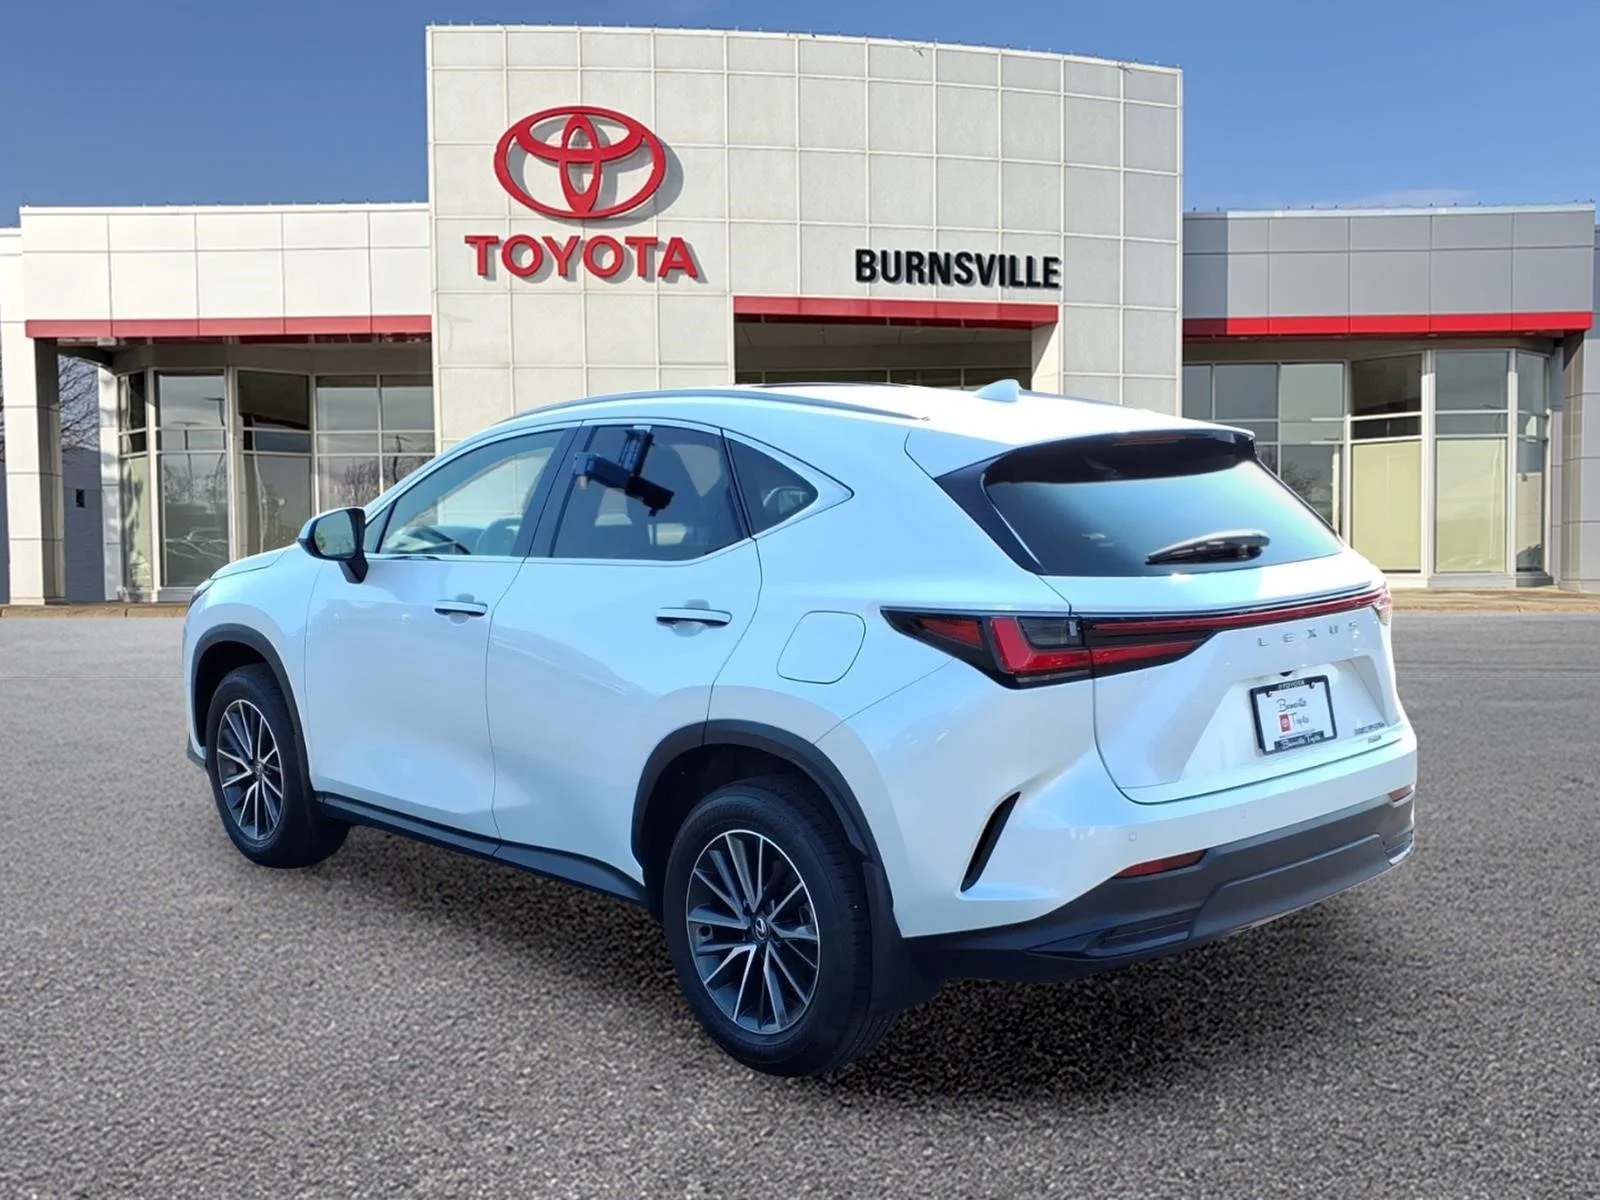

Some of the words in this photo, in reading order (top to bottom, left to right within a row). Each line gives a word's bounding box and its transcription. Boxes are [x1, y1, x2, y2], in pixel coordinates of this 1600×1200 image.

[464, 234, 699, 279] TOYOTA
[855, 248, 1062, 290] BURNSVILLE
[1257, 620, 1359, 647] LEXUS
